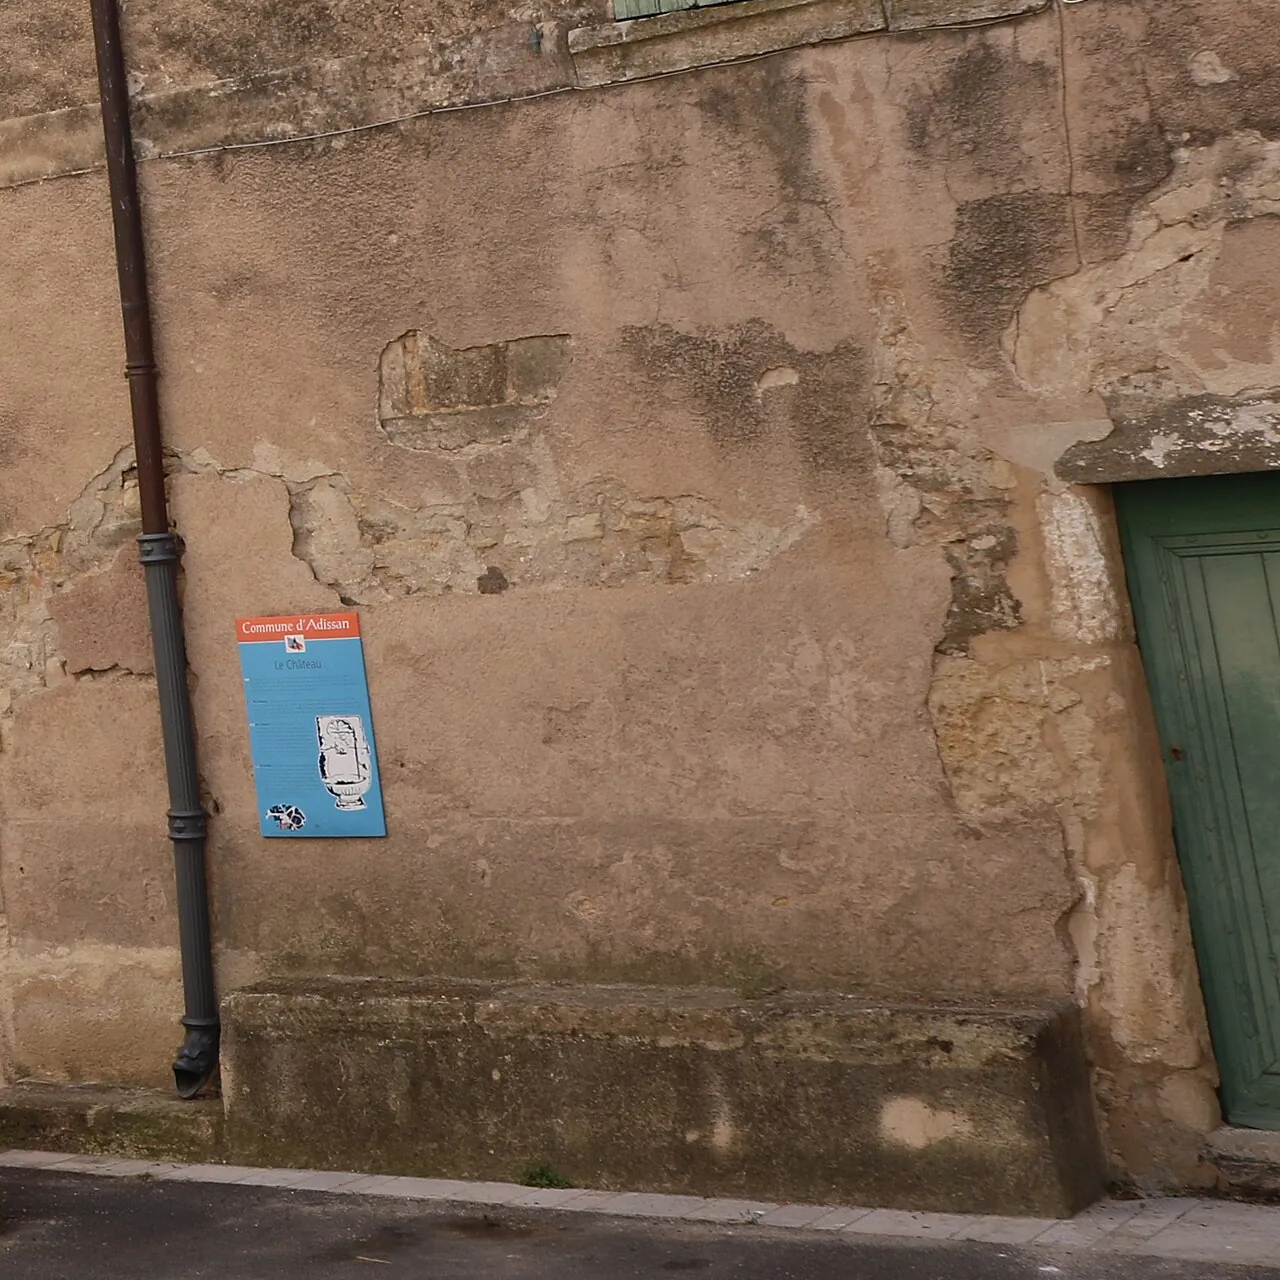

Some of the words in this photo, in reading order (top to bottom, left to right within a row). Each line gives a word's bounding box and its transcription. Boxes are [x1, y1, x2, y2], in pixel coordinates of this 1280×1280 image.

[242, 621, 293, 634] Commune
[296, 618, 350, 631] d'Adissan
[274, 660, 285, 671] Le
[286, 659, 322, 671] Château
